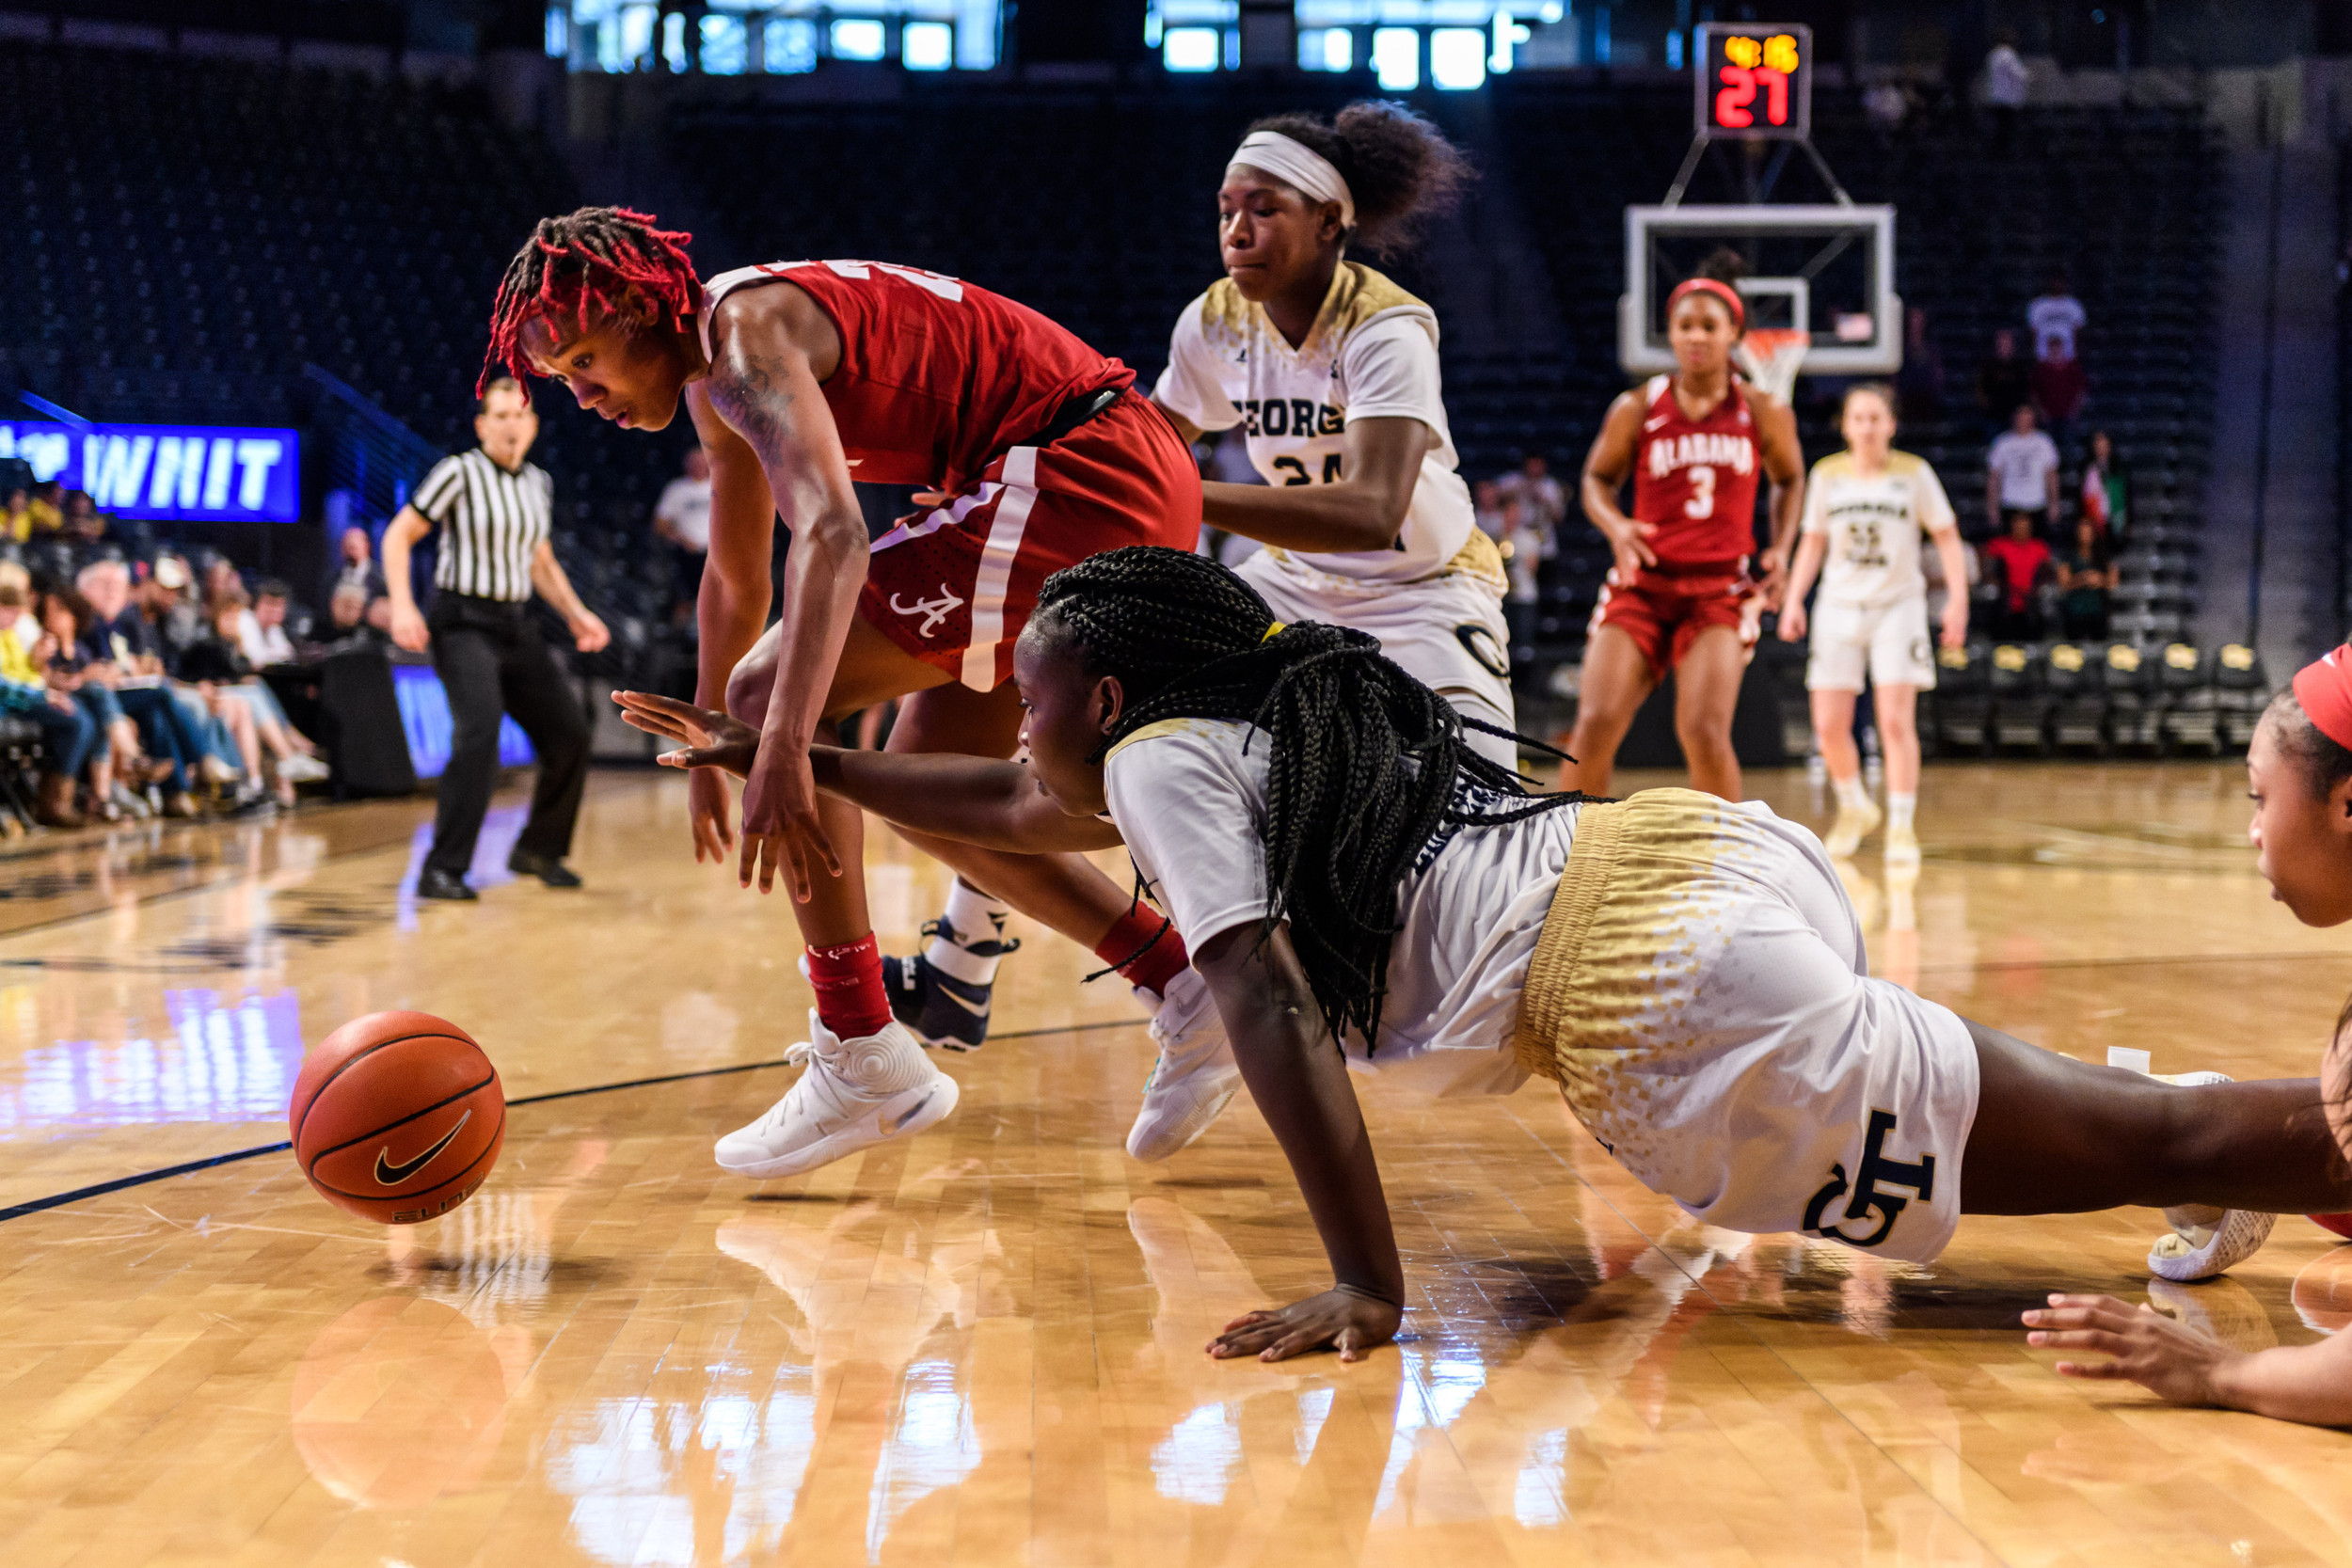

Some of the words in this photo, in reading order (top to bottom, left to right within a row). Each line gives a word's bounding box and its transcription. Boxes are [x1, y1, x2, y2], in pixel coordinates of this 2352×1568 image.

[1716, 66, 1788, 128] 27
[1649, 433, 1754, 480] ALABAMA
[1684, 465, 1717, 520] 3
[1801, 1106, 1937, 1247] GT
